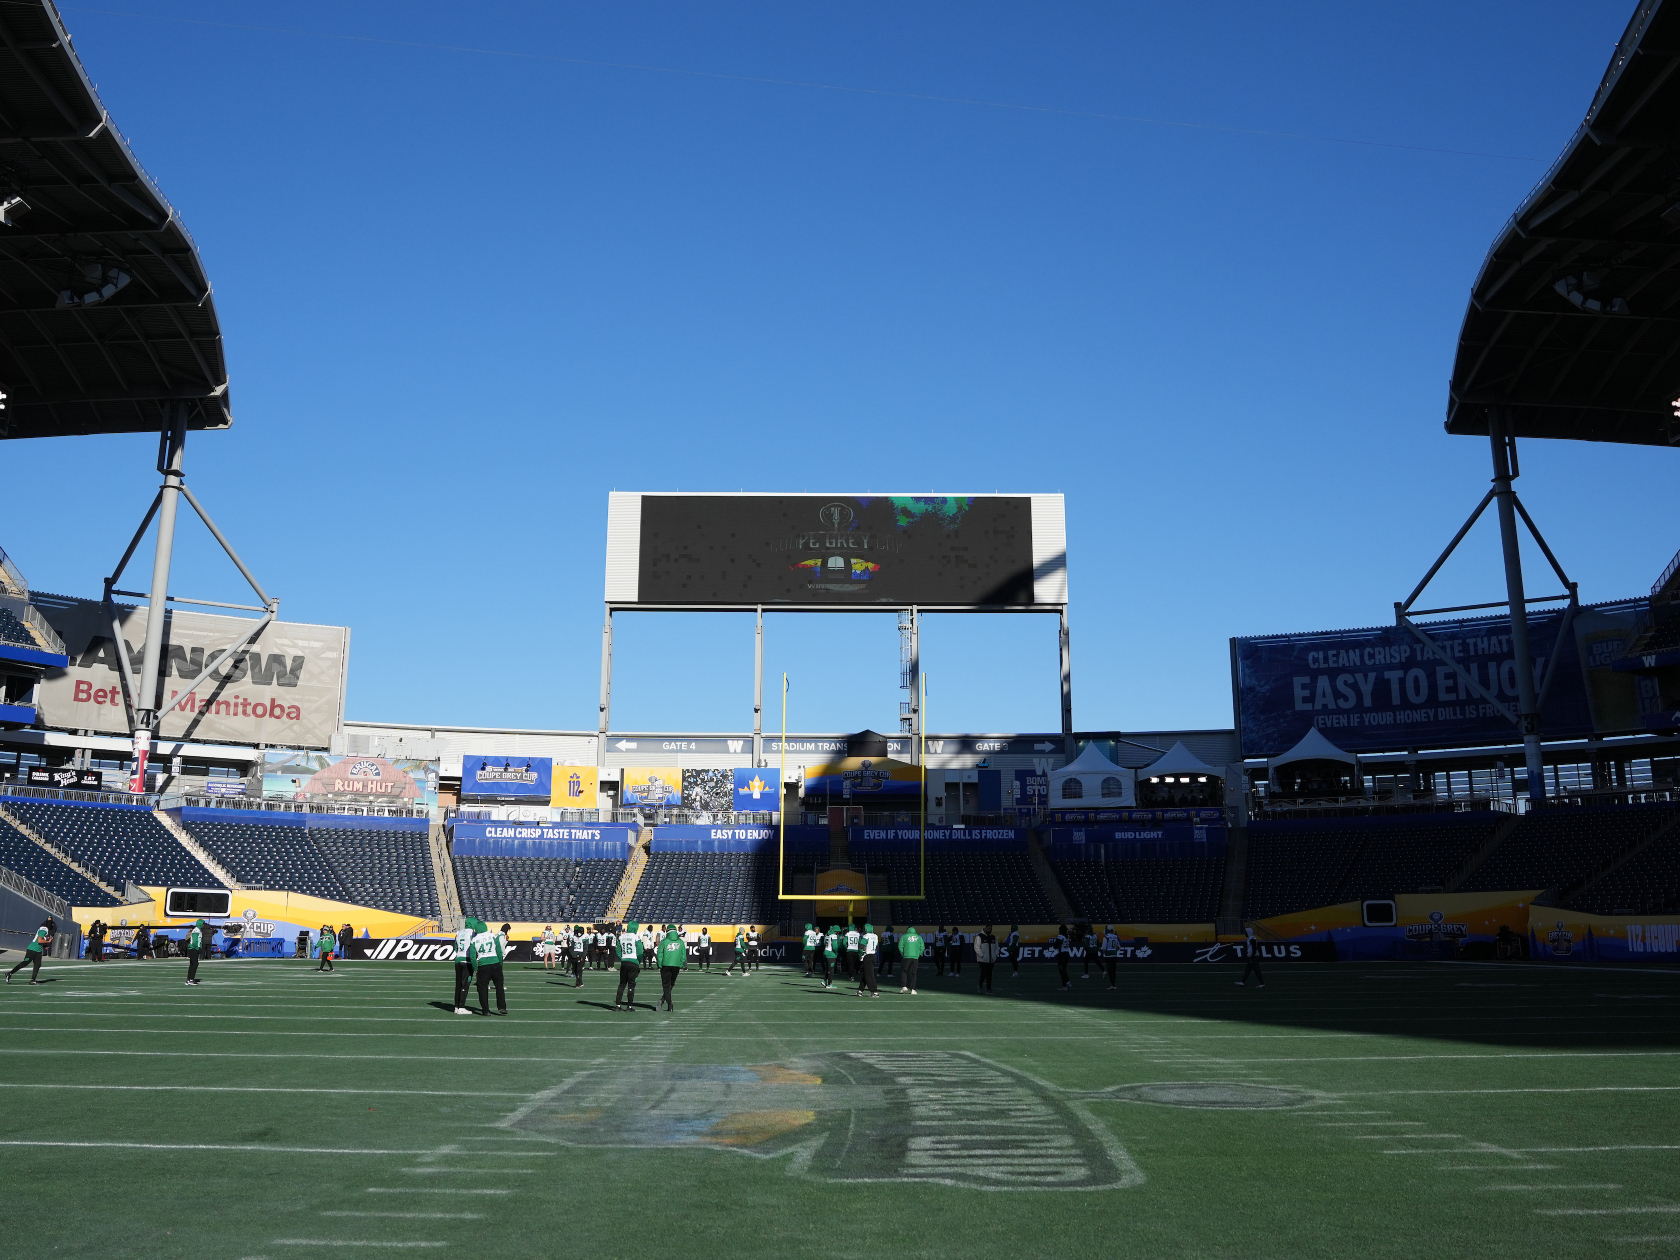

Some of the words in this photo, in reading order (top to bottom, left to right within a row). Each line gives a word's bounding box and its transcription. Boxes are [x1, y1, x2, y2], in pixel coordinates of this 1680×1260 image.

[70, 636, 305, 688] AYNOW
[1308, 648, 1361, 670] CLEAN
[1363, 645, 1410, 667] CRISP
[1292, 671, 1377, 711] EASY
[1384, 667, 1429, 706] TO
[73, 680, 120, 706] Bet
[170, 690, 302, 721] Manitoba
[1349, 714, 1361, 727] IF
[1362, 711, 1394, 726] YOUR
[1396, 708, 1434, 724] HONEY
[1437, 706, 1464, 721] DILL
[1466, 705, 1478, 718] IS
[662, 742, 687, 750] GATE
[690, 742, 696, 750] 4
[727, 740, 744, 753] W
[771, 742, 815, 751] STADIUM
[817, 742, 901, 751] TRANSON
[927, 740, 944, 754] W
[976, 742, 999, 751] GATE
[1002, 742, 1009, 751] 3
[352, 760, 381, 777] BRUGAL
[477, 770, 501, 781] COUPE
[502, 771, 522, 781] GREY
[523, 772, 538, 782] CUP
[335, 778, 363, 792] RUM
[368, 780, 395, 793] HUT
[568, 780, 581, 797] 112
[486, 827, 516, 838] CLEAN
[517, 827, 542, 838] CRISP
[543, 828, 570, 839] TASTE
[571, 828, 601, 840] THAT'S
[711, 829, 733, 840] EASY
[735, 829, 746, 840] TO
[748, 829, 775, 840] ENJOY
[864, 829, 888, 840] EVEN
[888, 829, 896, 840] IF
[897, 829, 920, 840] YOUR
[952, 829, 971, 840] DILL
[972, 829, 981, 839] IS
[982, 829, 1015, 839] FROZEN
[1114, 831, 1134, 839] BUD
[1135, 831, 1164, 839] LIGHT
[253, 922, 274, 934] CUP
[1440, 923, 1468, 936] GREY
[388, 939, 517, 960] Puror
[478, 942, 493, 953] 47
[1232, 945, 1303, 958] TLUS
[898, 1134, 1092, 1182] CUP
